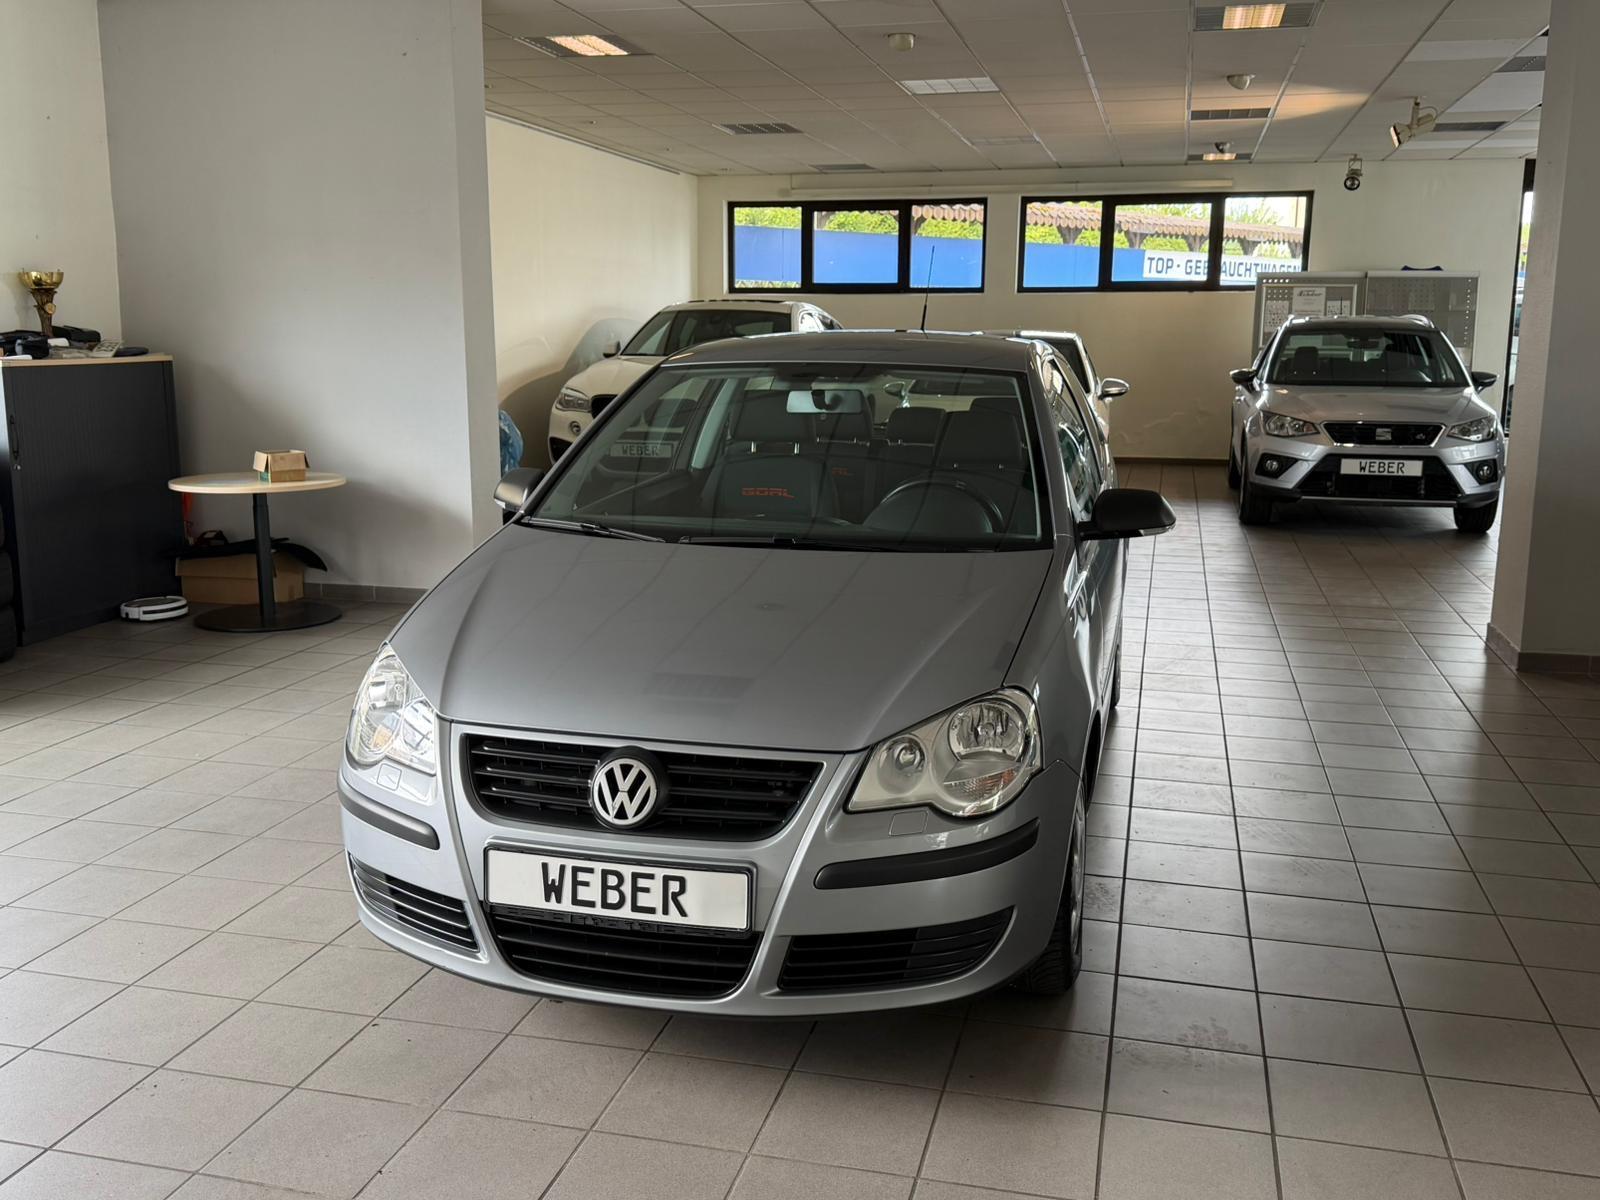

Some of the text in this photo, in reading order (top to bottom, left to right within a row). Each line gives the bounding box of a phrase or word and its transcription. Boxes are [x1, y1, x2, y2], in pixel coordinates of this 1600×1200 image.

[1147, 257, 1174, 275] TOP
[622, 444, 661, 456] WEBER
[1359, 461, 1405, 474] WEBER
[541, 862, 688, 917] WEBER
